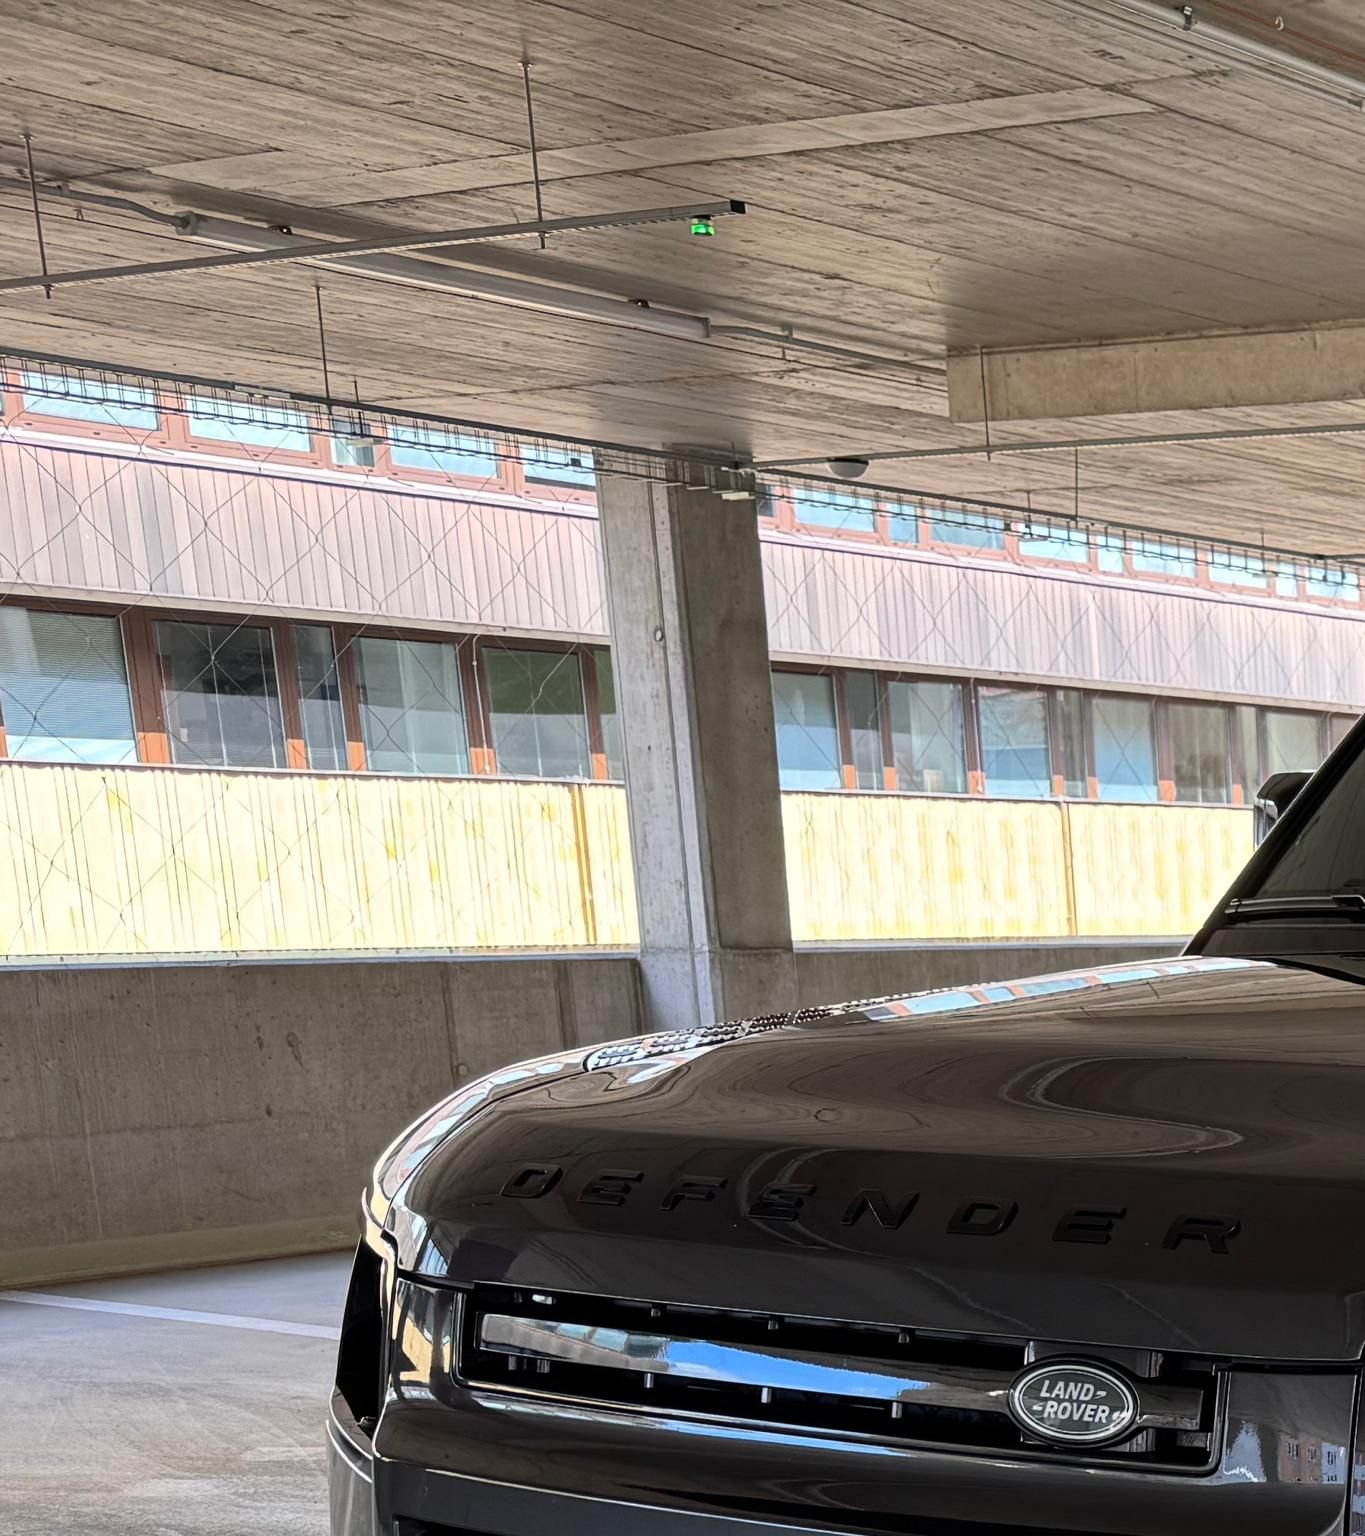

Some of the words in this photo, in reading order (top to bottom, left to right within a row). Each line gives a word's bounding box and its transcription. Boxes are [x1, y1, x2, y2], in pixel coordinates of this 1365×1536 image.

[500, 1163, 1242, 1255] DEFENDER
[1039, 1380, 1095, 1401] LAND
[1042, 1400, 1110, 1423] ROVER
